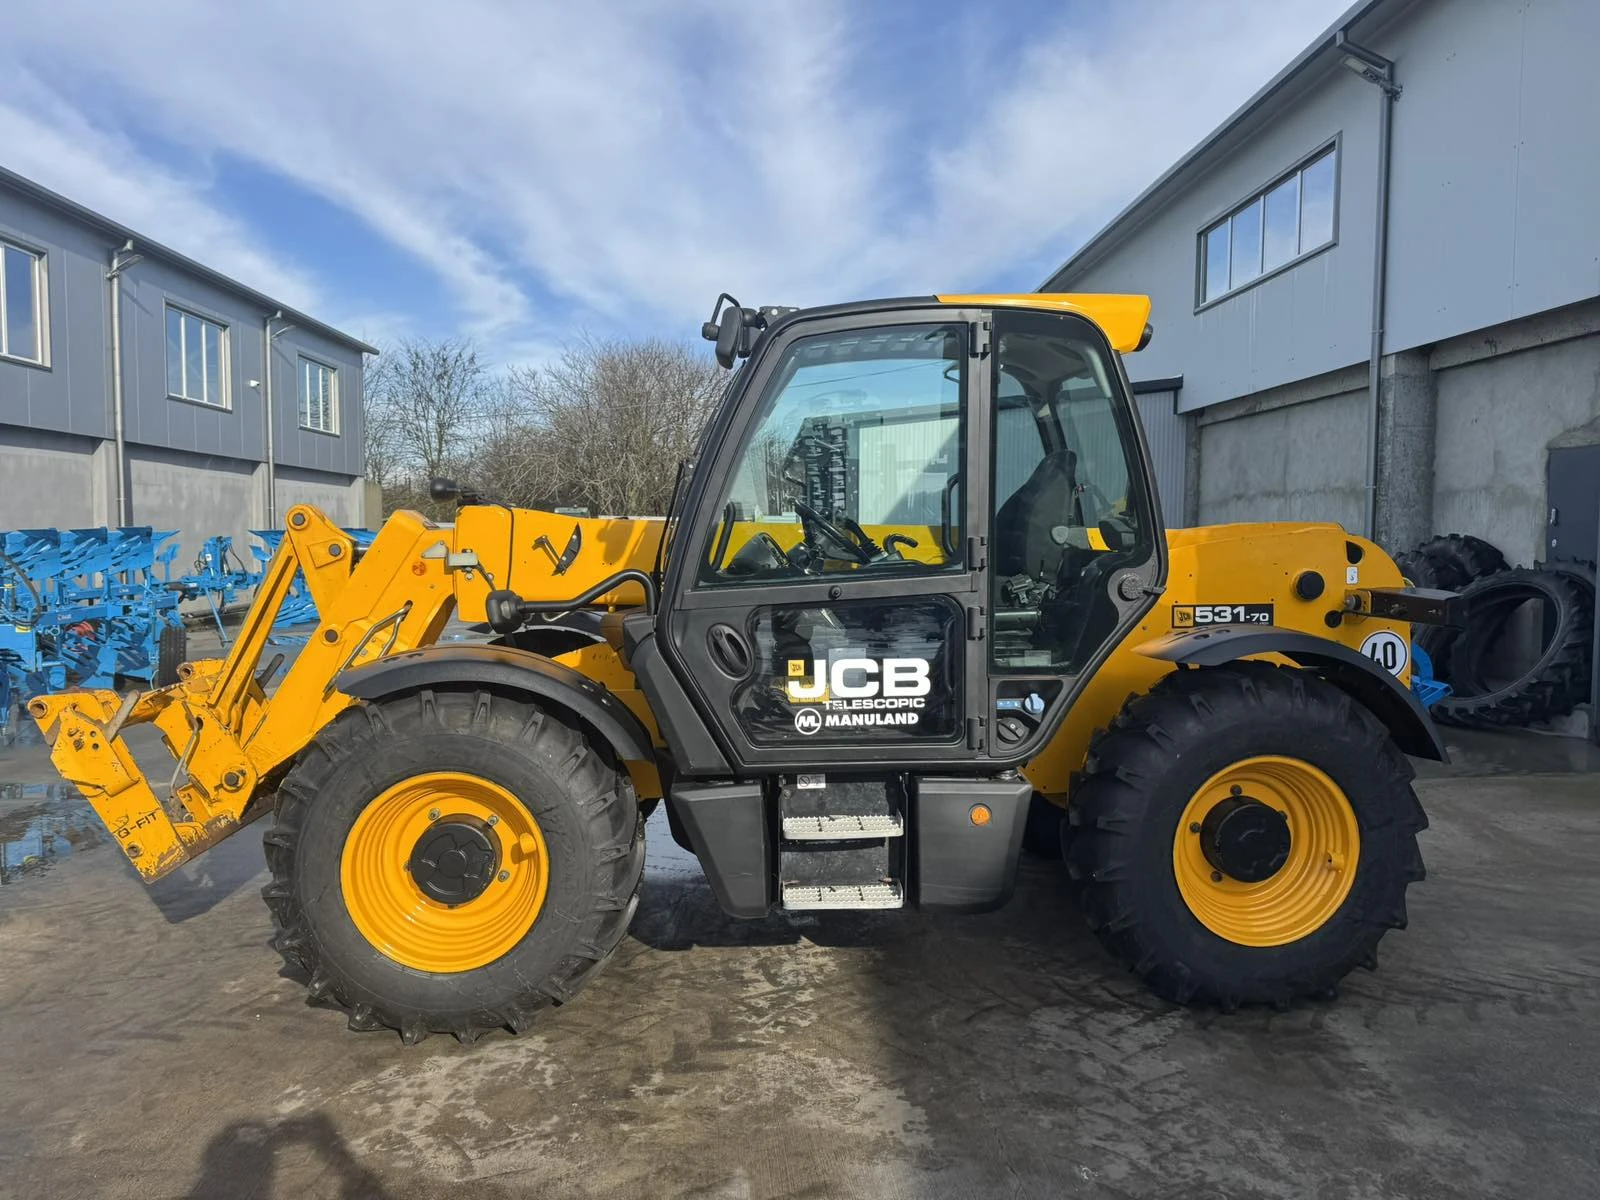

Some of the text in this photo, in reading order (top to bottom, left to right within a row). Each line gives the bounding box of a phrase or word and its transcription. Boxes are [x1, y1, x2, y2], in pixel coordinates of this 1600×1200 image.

[1195, 606, 1269, 623] 531-70
[788, 658, 931, 698] JCB
[822, 697, 926, 711] TELESCOPIC
[825, 712, 920, 727] MANULAND
[117, 812, 157, 839] Q-FIT
